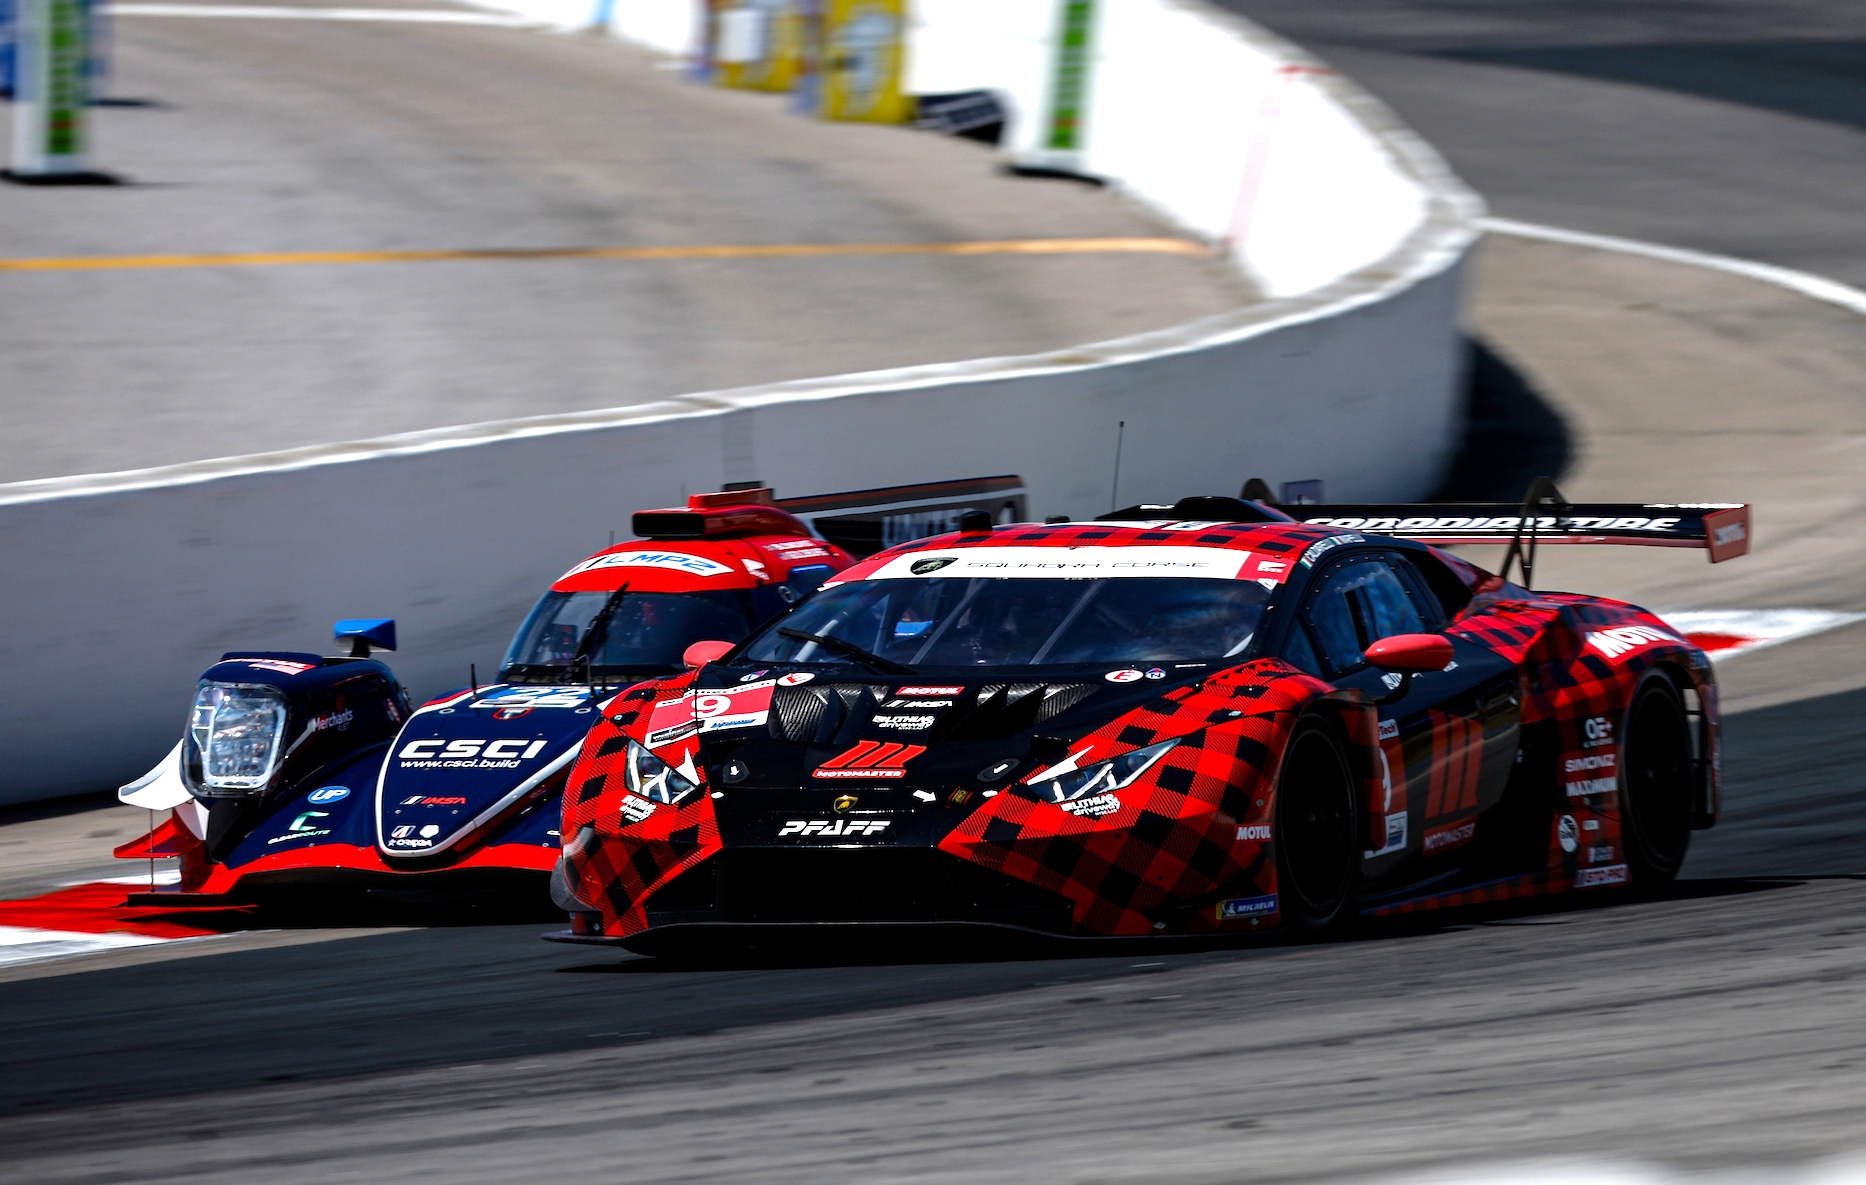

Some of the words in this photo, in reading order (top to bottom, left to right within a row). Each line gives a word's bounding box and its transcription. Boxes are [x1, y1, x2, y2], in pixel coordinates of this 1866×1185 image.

[1567, 516, 1681, 531] TIRE
[604, 554, 717, 572] LMP2
[966, 561, 1100, 569] SQUADRA
[1112, 561, 1210, 569] CORSE
[689, 695, 732, 720] 9
[398, 739, 548, 759] CSCI
[400, 759, 521, 768] www.csci.build
[310, 789, 348, 800] UP
[421, 796, 466, 804] IMSA
[777, 819, 891, 836] PFAFF
[1236, 825, 1271, 840] MOTUL
[1237, 900, 1275, 912] MICHELIN
